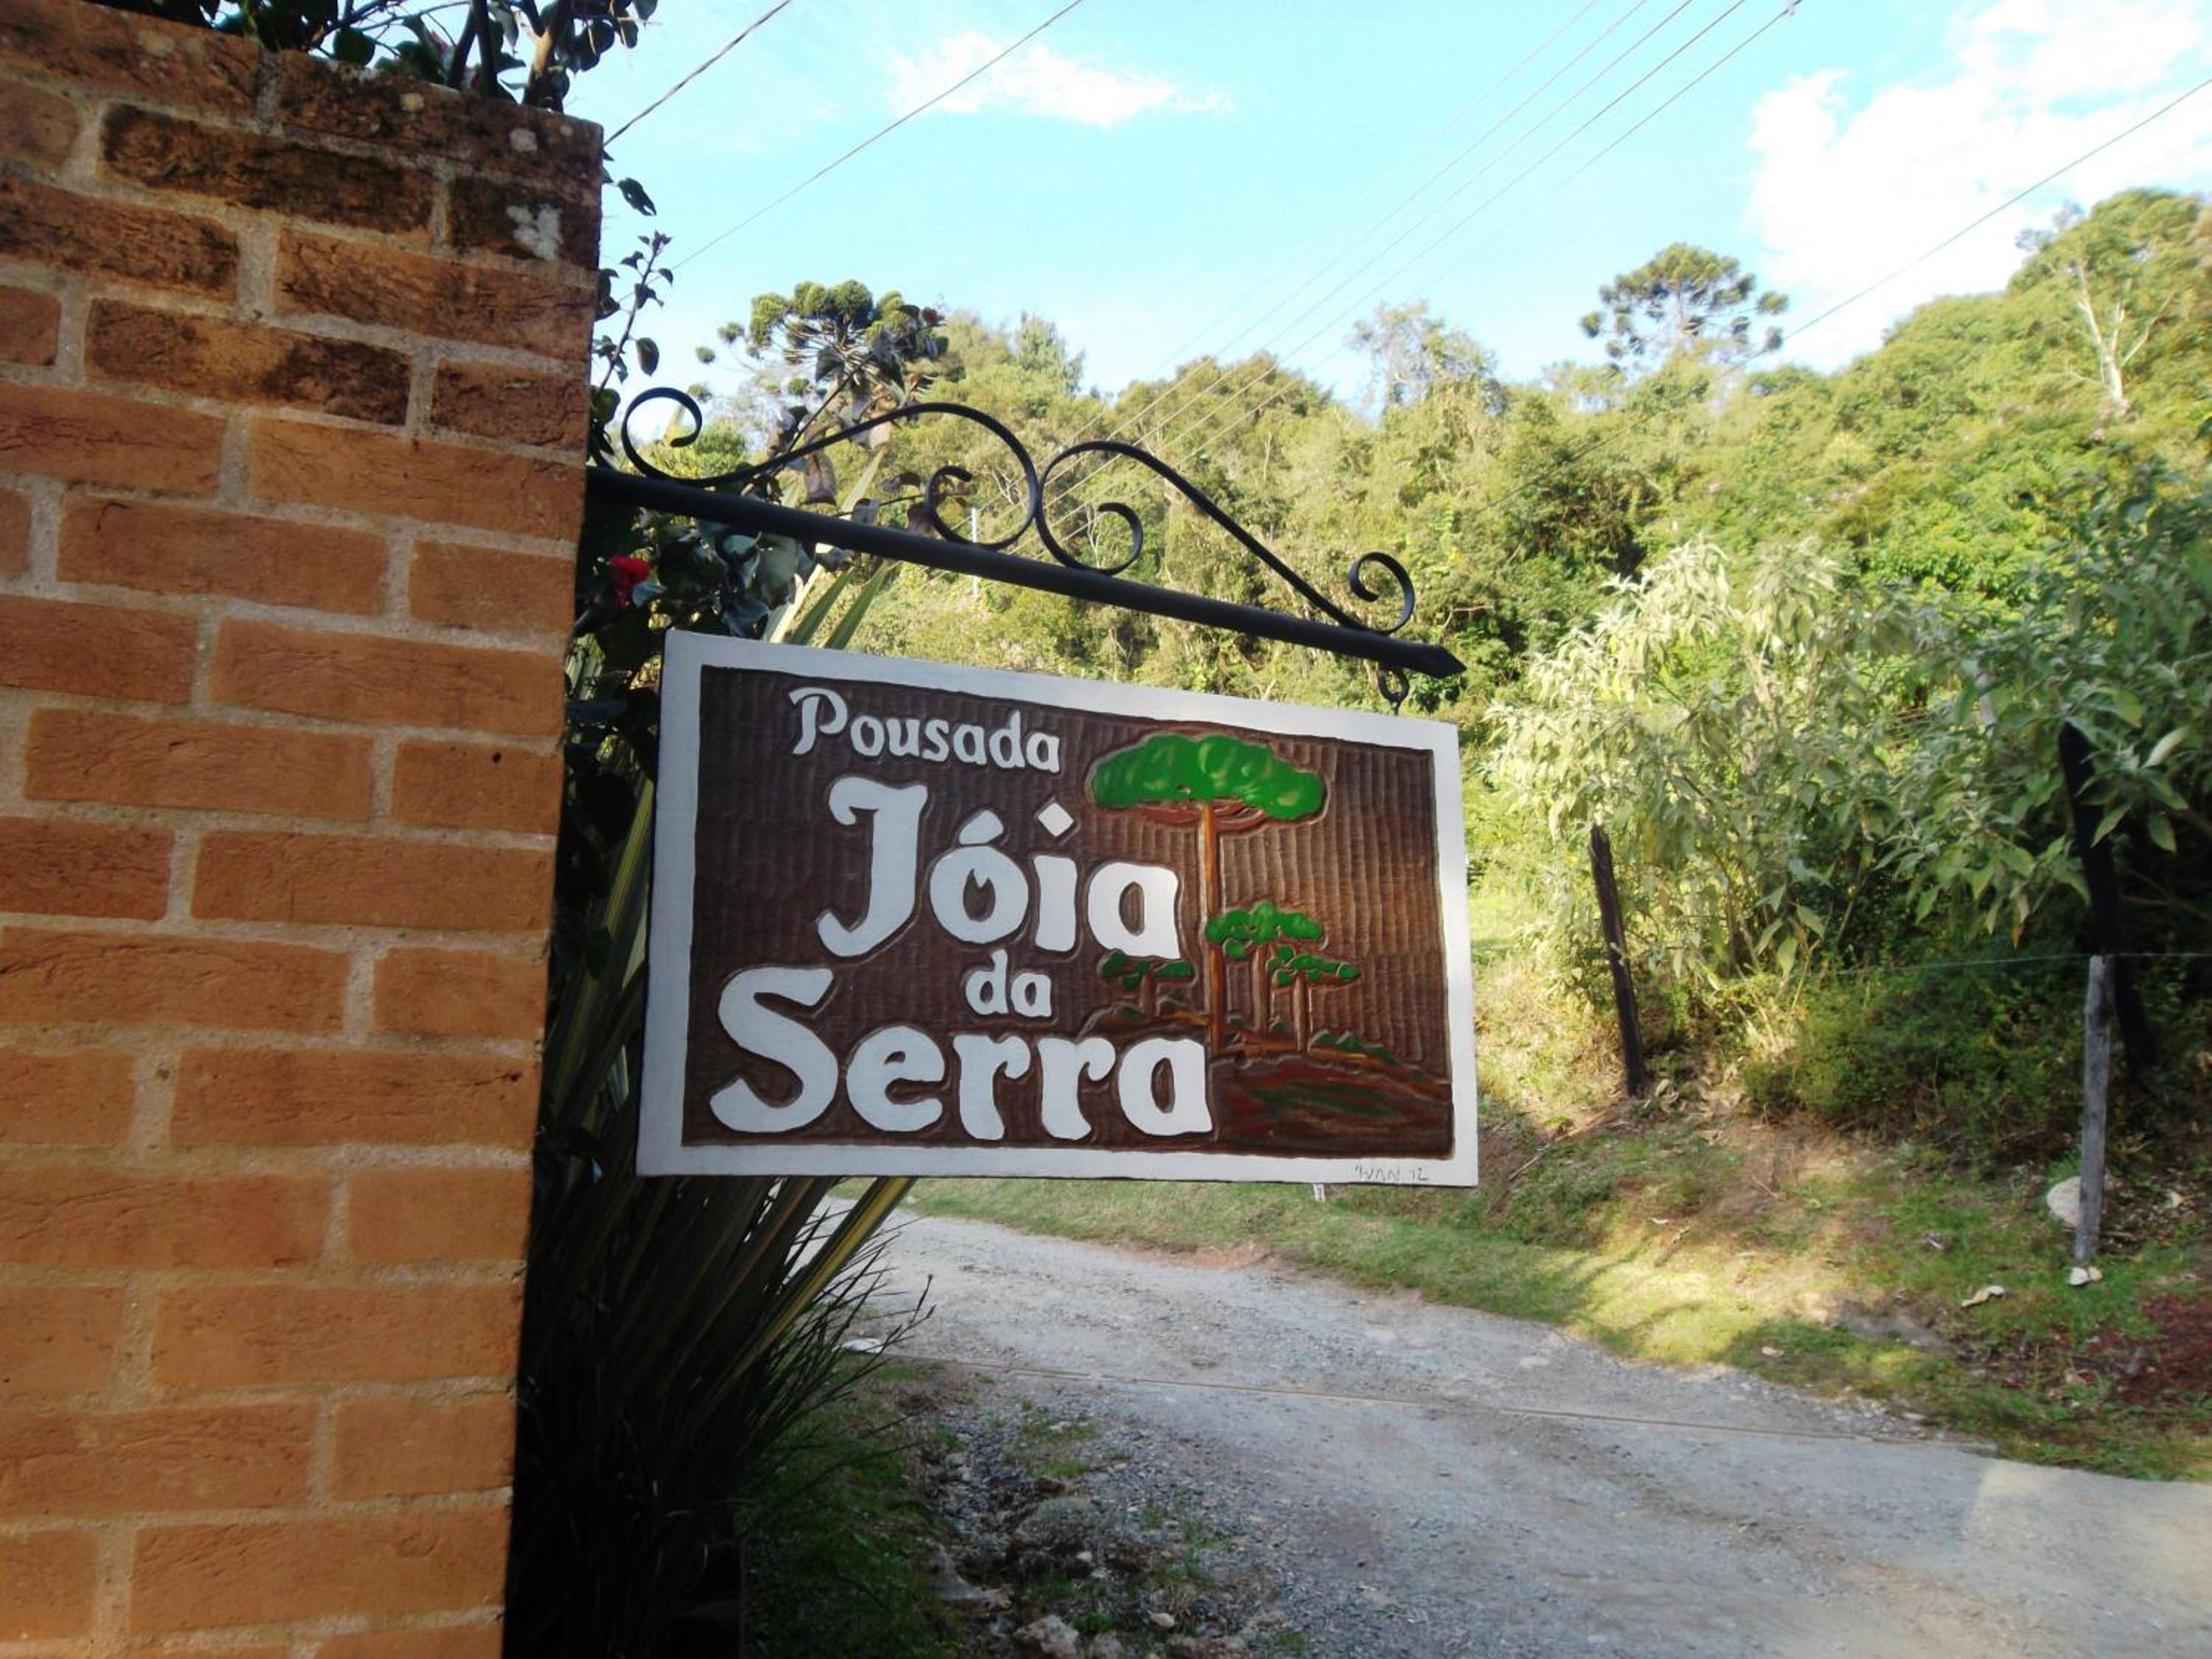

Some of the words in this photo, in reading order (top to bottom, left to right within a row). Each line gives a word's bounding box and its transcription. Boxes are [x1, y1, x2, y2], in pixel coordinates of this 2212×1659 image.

[788, 687, 1060, 773] Pousada
[818, 776, 1181, 957] Jóia
[965, 949, 1052, 1017] da
[709, 967, 1213, 1141] Serra
